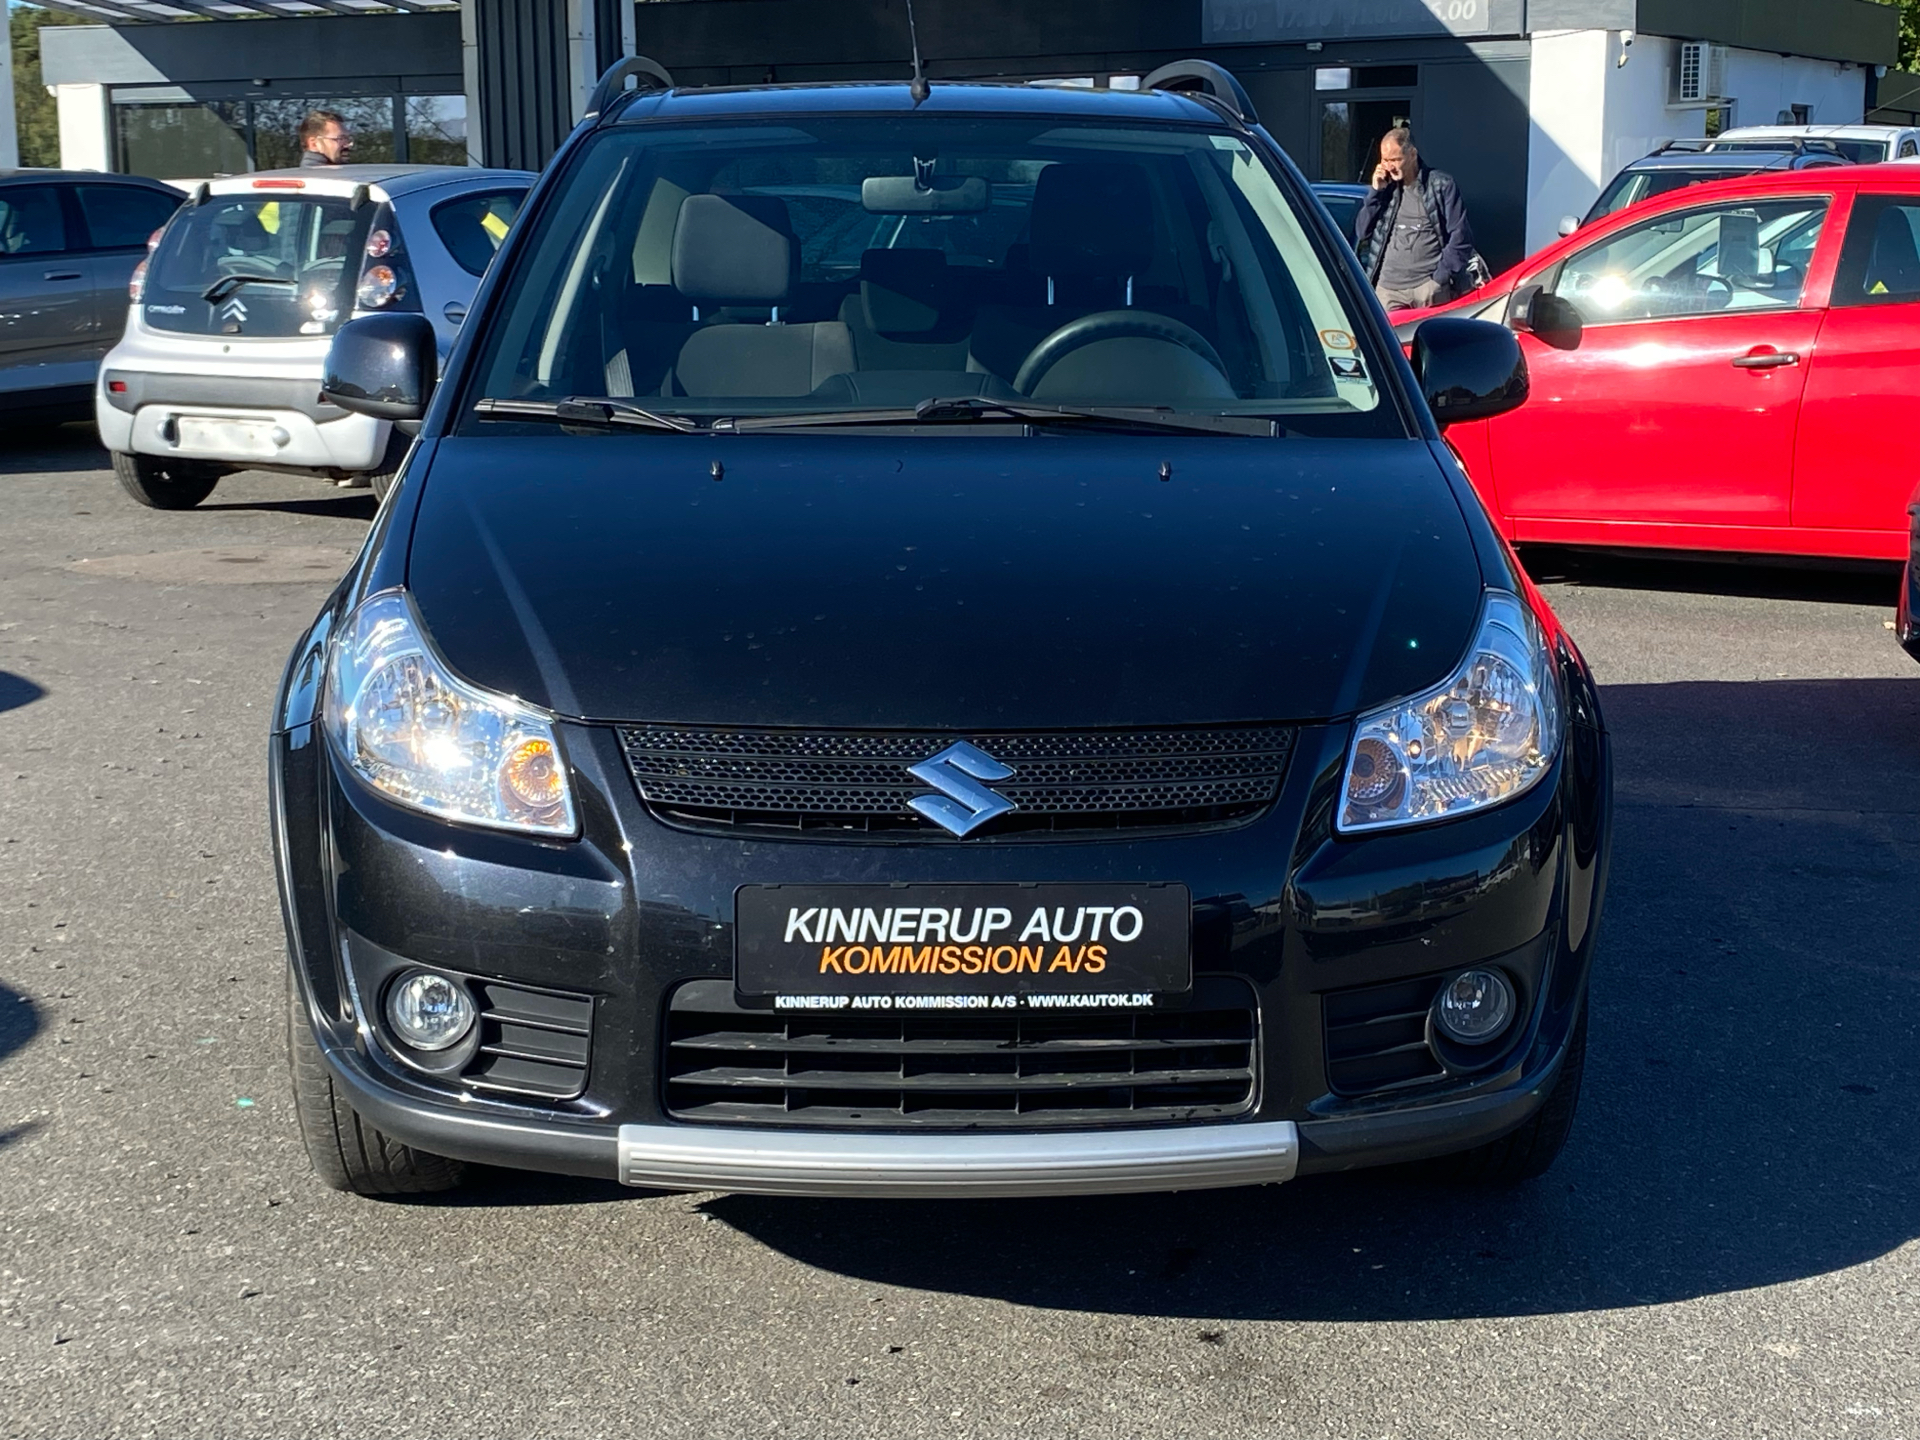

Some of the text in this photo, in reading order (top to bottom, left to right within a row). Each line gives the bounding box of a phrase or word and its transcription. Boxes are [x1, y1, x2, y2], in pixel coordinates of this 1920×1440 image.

[784, 904, 1144, 944] KINNERUP AUTO
[818, 943, 1108, 975] KOMMISSION A/S
[774, 994, 849, 1009] KINNERUP
[851, 994, 892, 1009] AUTO
[894, 994, 988, 1009] KOMMISSION
[990, 994, 1017, 1009] A/S
[1027, 992, 1154, 1008] WWW.KAUTOK.DK
